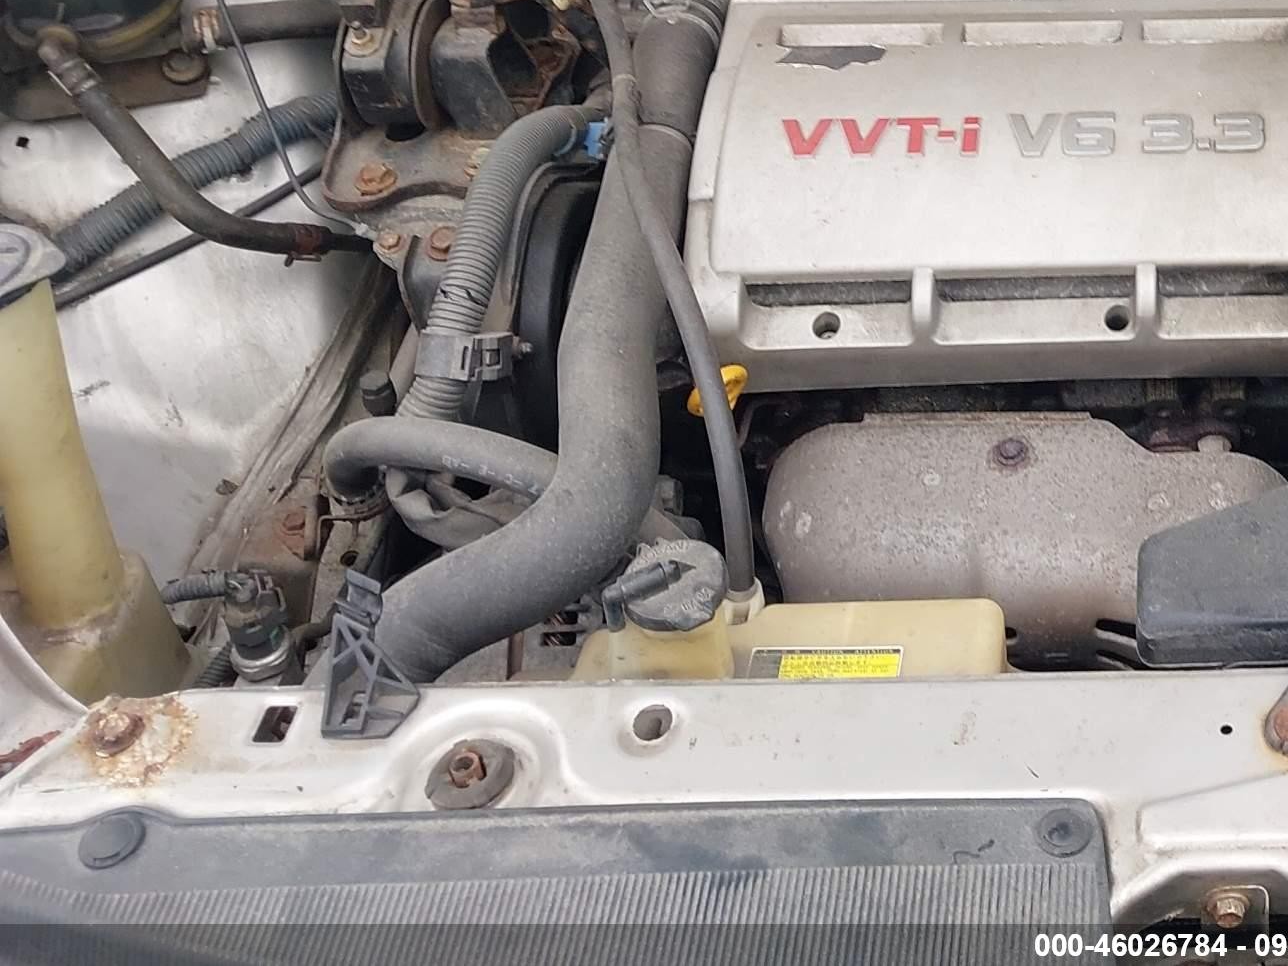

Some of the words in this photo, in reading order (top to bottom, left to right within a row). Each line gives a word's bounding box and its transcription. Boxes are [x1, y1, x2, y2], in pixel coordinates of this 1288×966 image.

[781, 115, 983, 159] VVT-i
[1009, 111, 1117, 158] V6
[1142, 112, 1267, 154] 3.3
